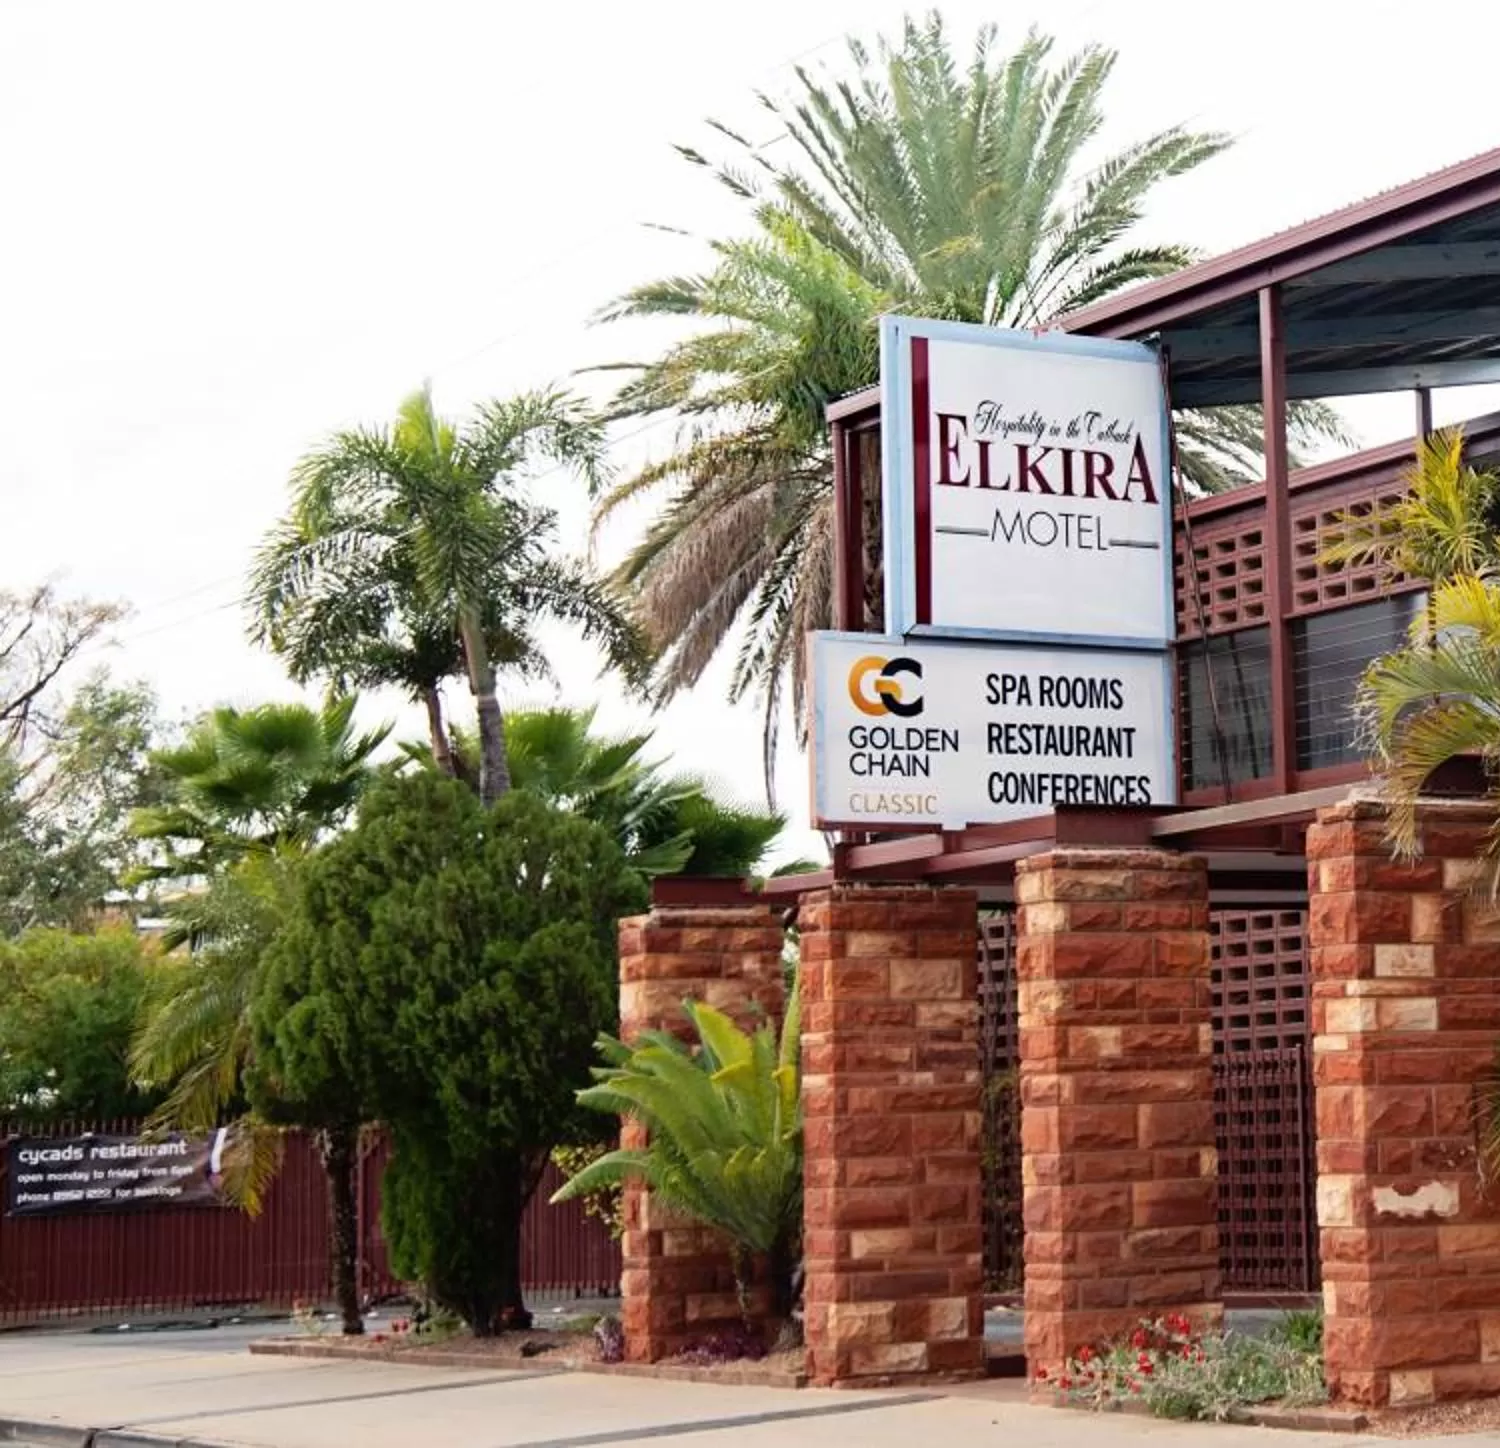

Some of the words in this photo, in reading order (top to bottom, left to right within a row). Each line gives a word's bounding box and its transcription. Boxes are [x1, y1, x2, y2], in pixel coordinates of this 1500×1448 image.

[974, 400, 1046, 446] Hospitality
[1050, 419, 1061, 437] in
[1066, 415, 1080, 438] the
[1084, 411, 1134, 444] Outback
[934, 412, 1159, 504] ELKIRA
[991, 508, 1108, 550] MOTEL
[986, 673, 1032, 707] SPA
[1039, 676, 1123, 710] ROOMS
[849, 725, 959, 752] GOLDEN
[987, 723, 1136, 759] RESTAURANT
[849, 752, 930, 777] CHAIN
[988, 771, 1152, 804] CONFERENCES
[850, 793, 938, 815] CLASSIC
[18, 1145, 84, 1165] cycads
[90, 1139, 188, 1160] restaurant
[17, 1173, 44, 1184] open
[47, 1170, 90, 1182] monday
[93, 1168, 105, 1180] to
[107, 1168, 139, 1180] friday
[142, 1166, 168, 1177] from
[17, 1191, 50, 1205] phone
[115, 1187, 132, 1199] for
